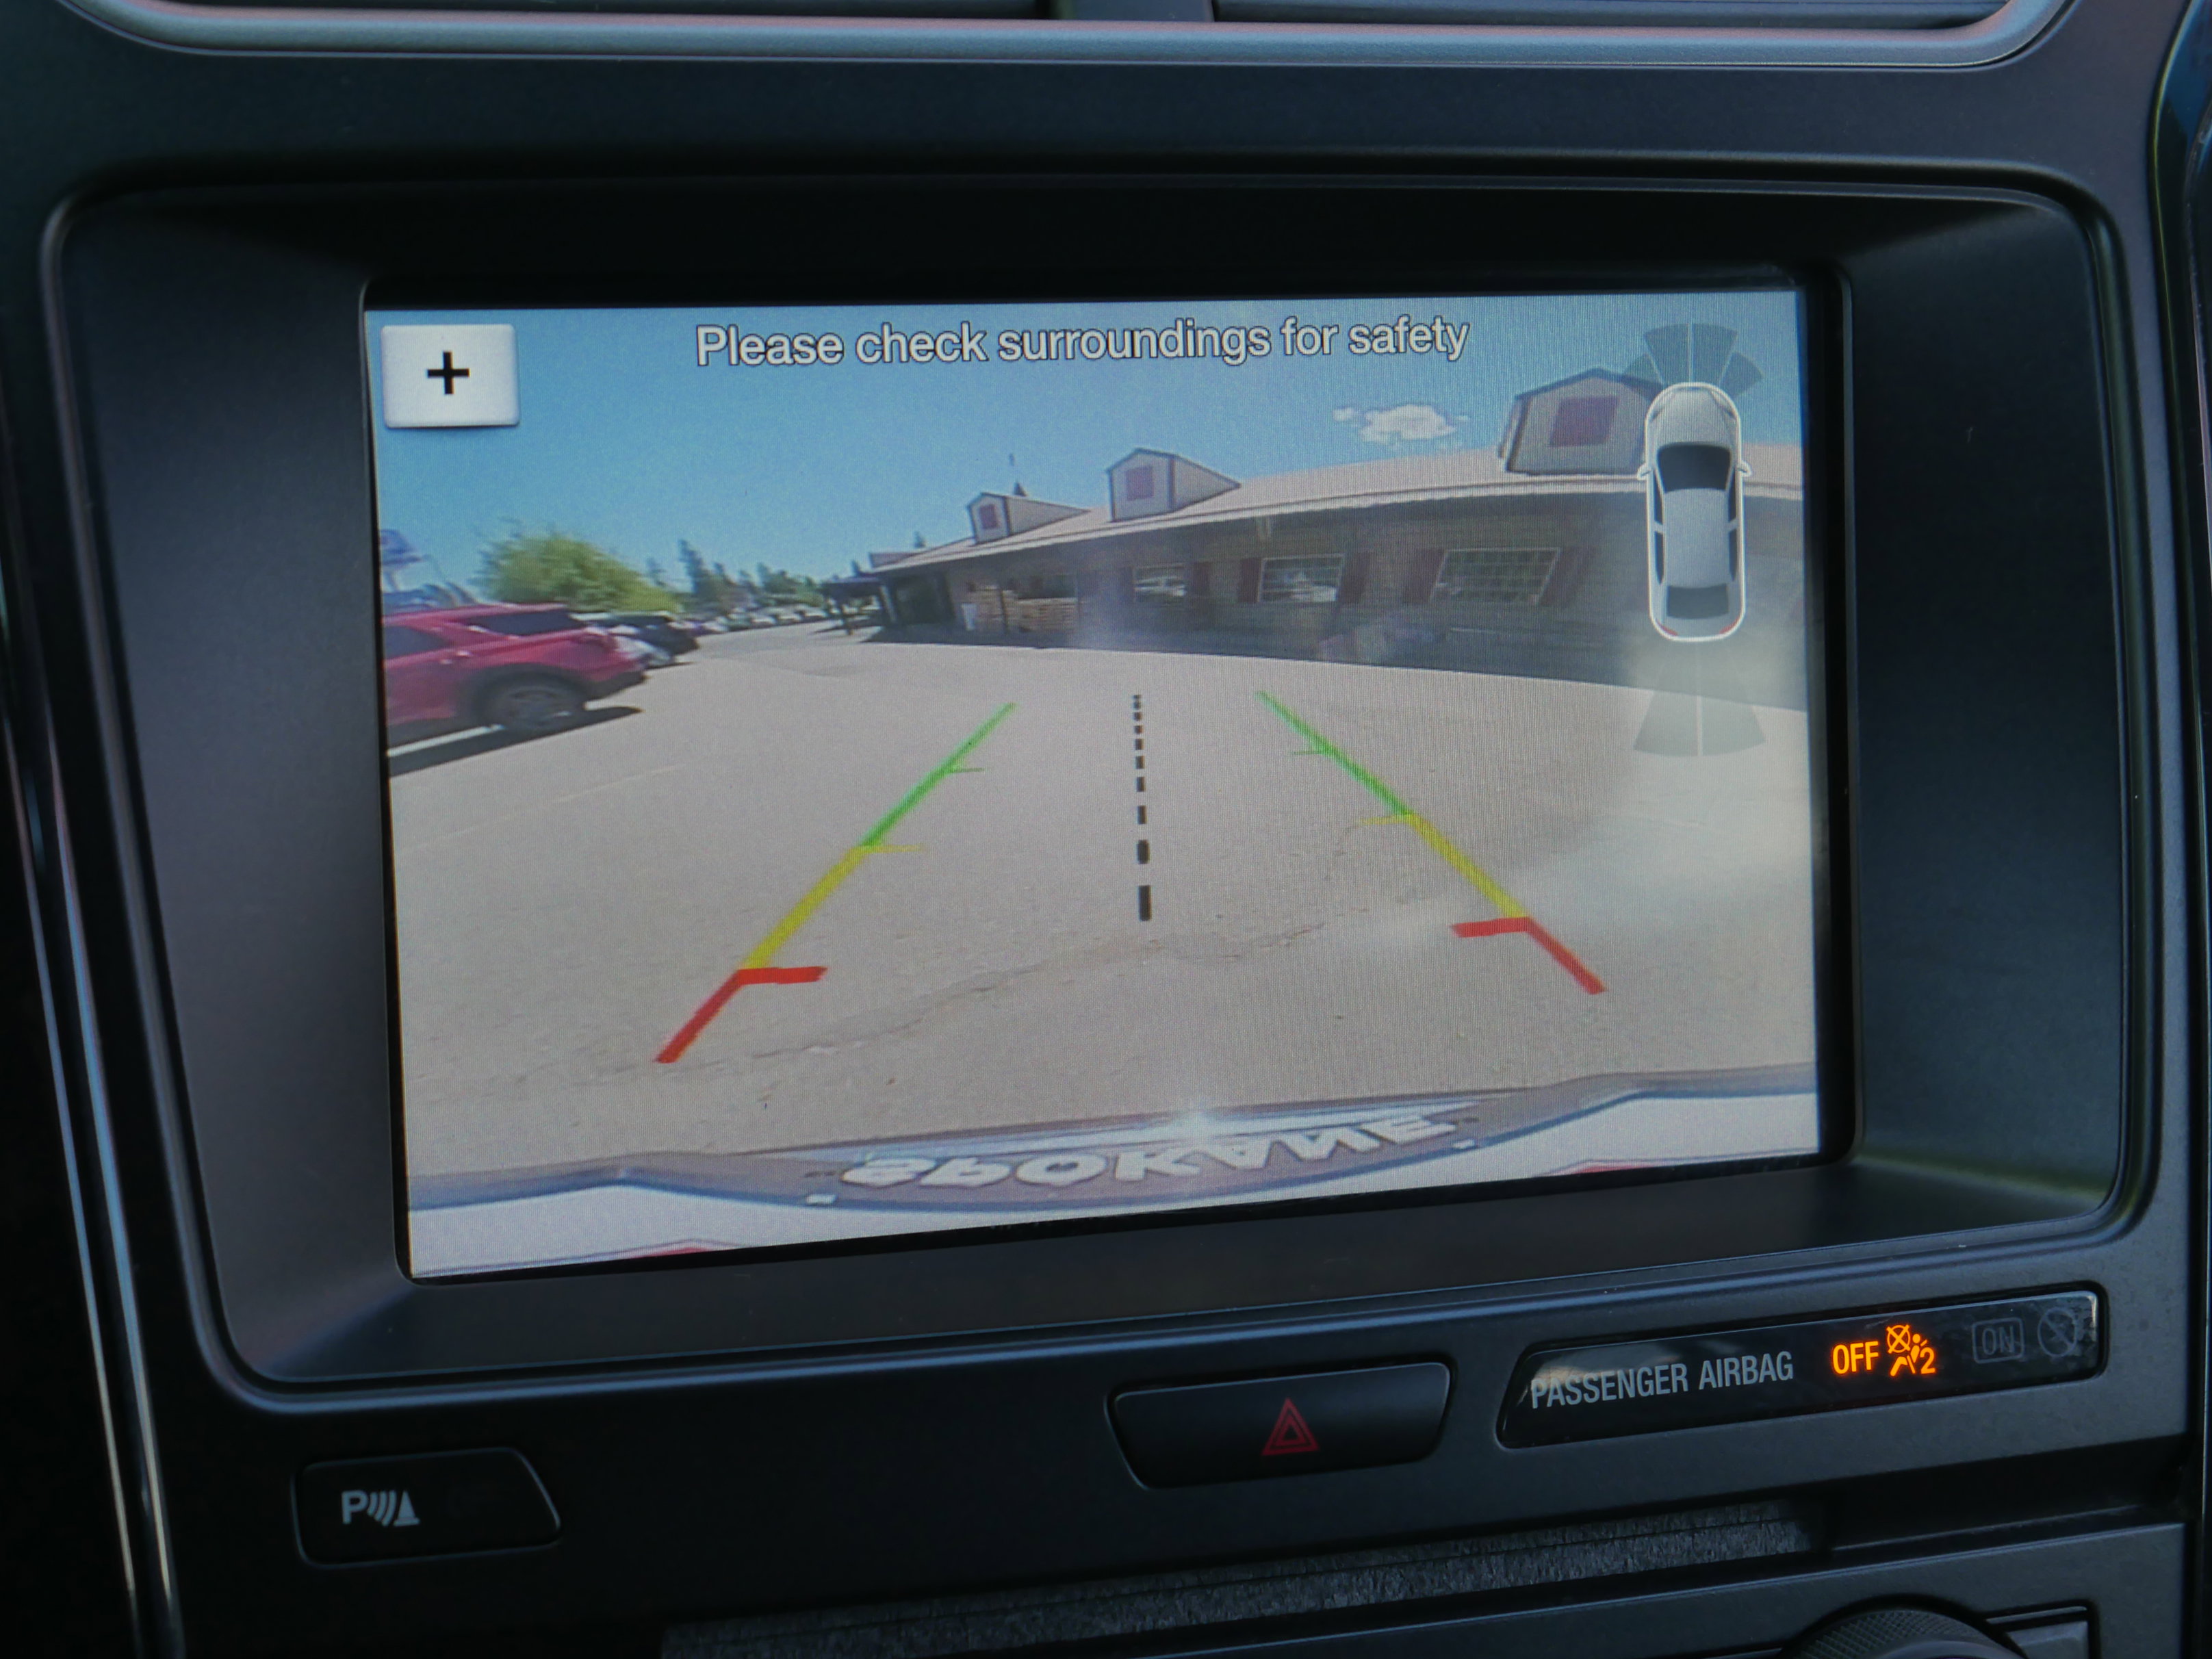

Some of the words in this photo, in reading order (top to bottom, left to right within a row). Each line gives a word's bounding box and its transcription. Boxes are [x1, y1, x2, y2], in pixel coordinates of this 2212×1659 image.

[696, 324, 845, 366] Please
[856, 321, 990, 363] check
[997, 318, 1272, 365] surroundings
[1281, 316, 1339, 355] for
[1348, 314, 1471, 361] safety
[1831, 1340, 1879, 1375] OFF
[1982, 1325, 2016, 1356] ON
[1530, 1363, 1689, 1409] PASSENGER
[1698, 1350, 1795, 1390] AIRBAG
